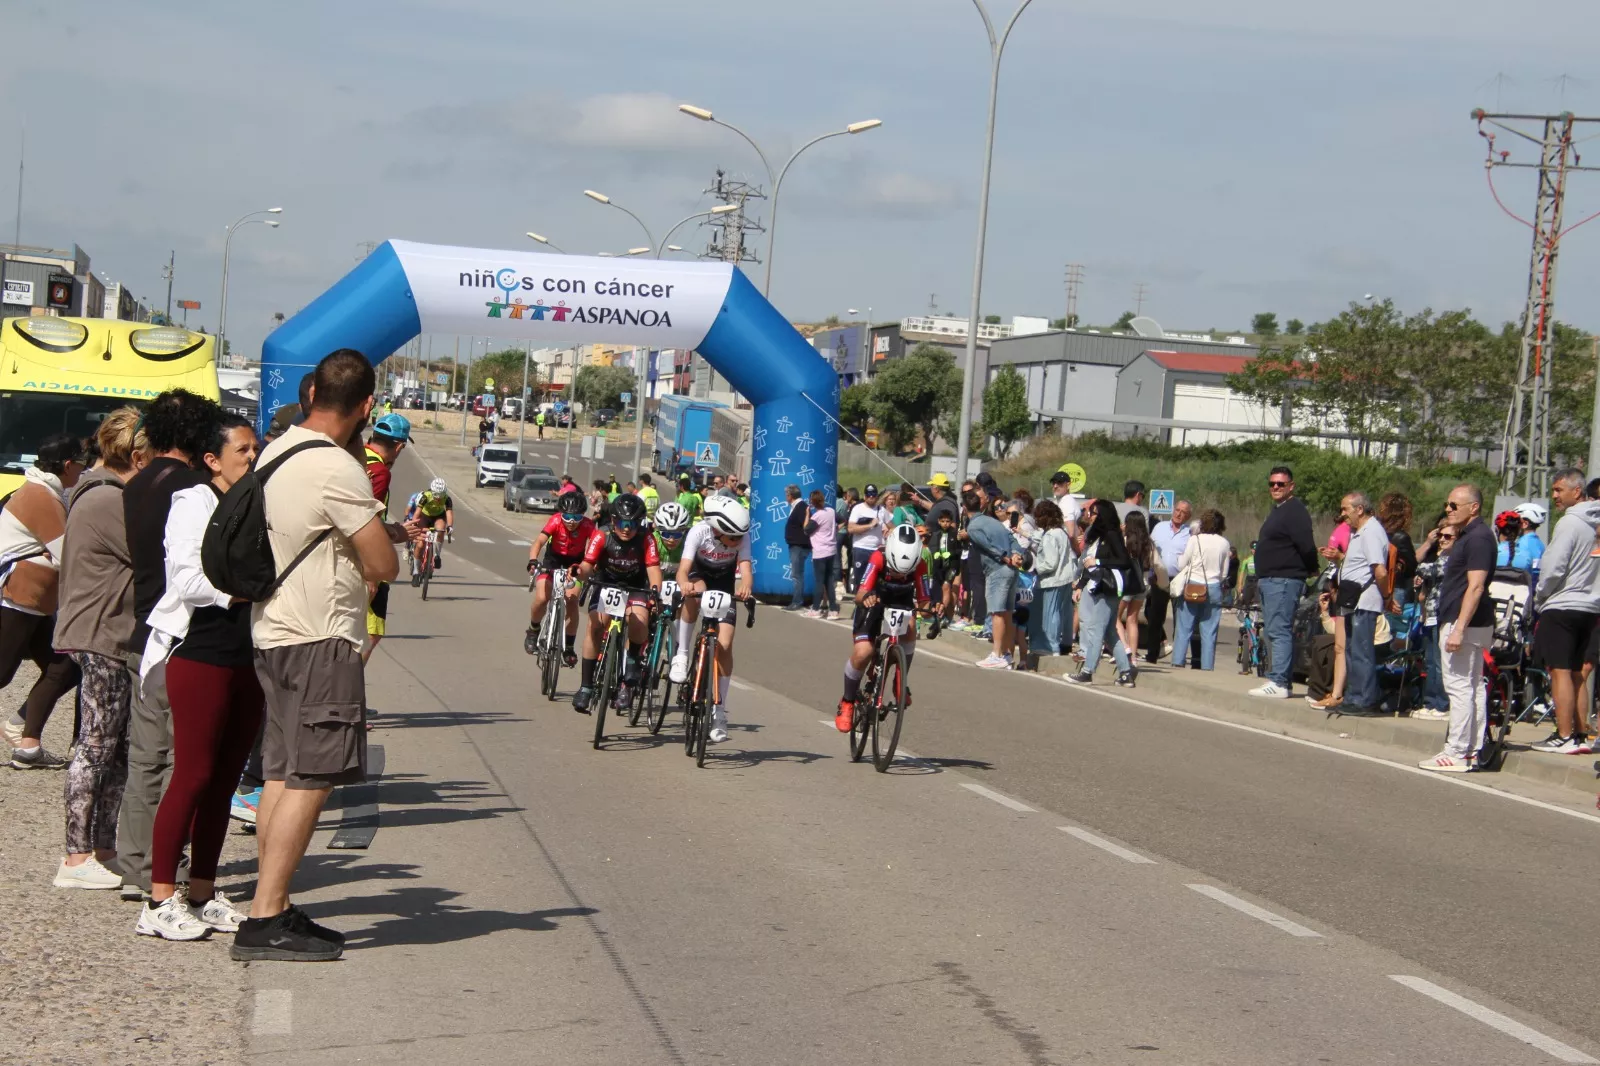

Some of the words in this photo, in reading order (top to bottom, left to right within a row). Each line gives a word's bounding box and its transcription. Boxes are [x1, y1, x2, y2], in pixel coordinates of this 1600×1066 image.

[543, 277, 586, 294] con
[594, 278, 675, 299] cáncer
[571, 306, 673, 328] ASPANOA
[605, 588, 622, 607] 55
[708, 592, 724, 610] 57
[890, 610, 905, 627] 54
